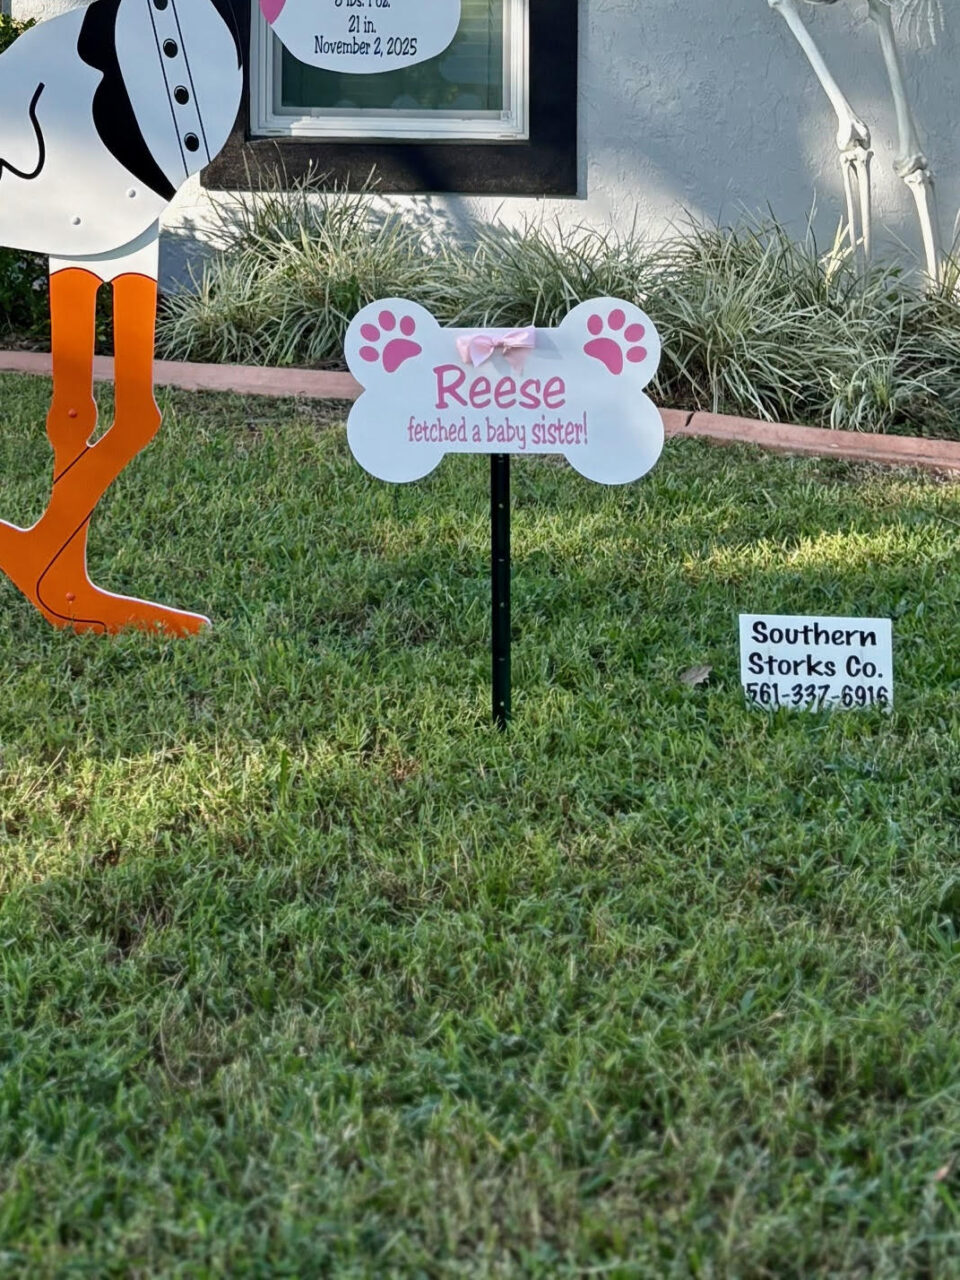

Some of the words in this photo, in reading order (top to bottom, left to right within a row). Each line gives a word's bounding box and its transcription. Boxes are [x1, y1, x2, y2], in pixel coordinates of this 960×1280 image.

[348, 15, 360, 33] 21
[363, 16, 377, 34] in.
[314, 35, 371, 55] November
[374, 37, 384, 58] 2,
[386, 37, 418, 56] 2025
[432, 364, 566, 410] Reese
[407, 416, 467, 443] fetched
[472, 425, 482, 443] a
[486, 417, 527, 450] baby
[531, 411, 589, 446] sister!
[751, 620, 877, 647] Southern
[747, 651, 837, 677] Storks
[846, 655, 883, 678] Co.
[746, 682, 889, 708] 561-337-6916
